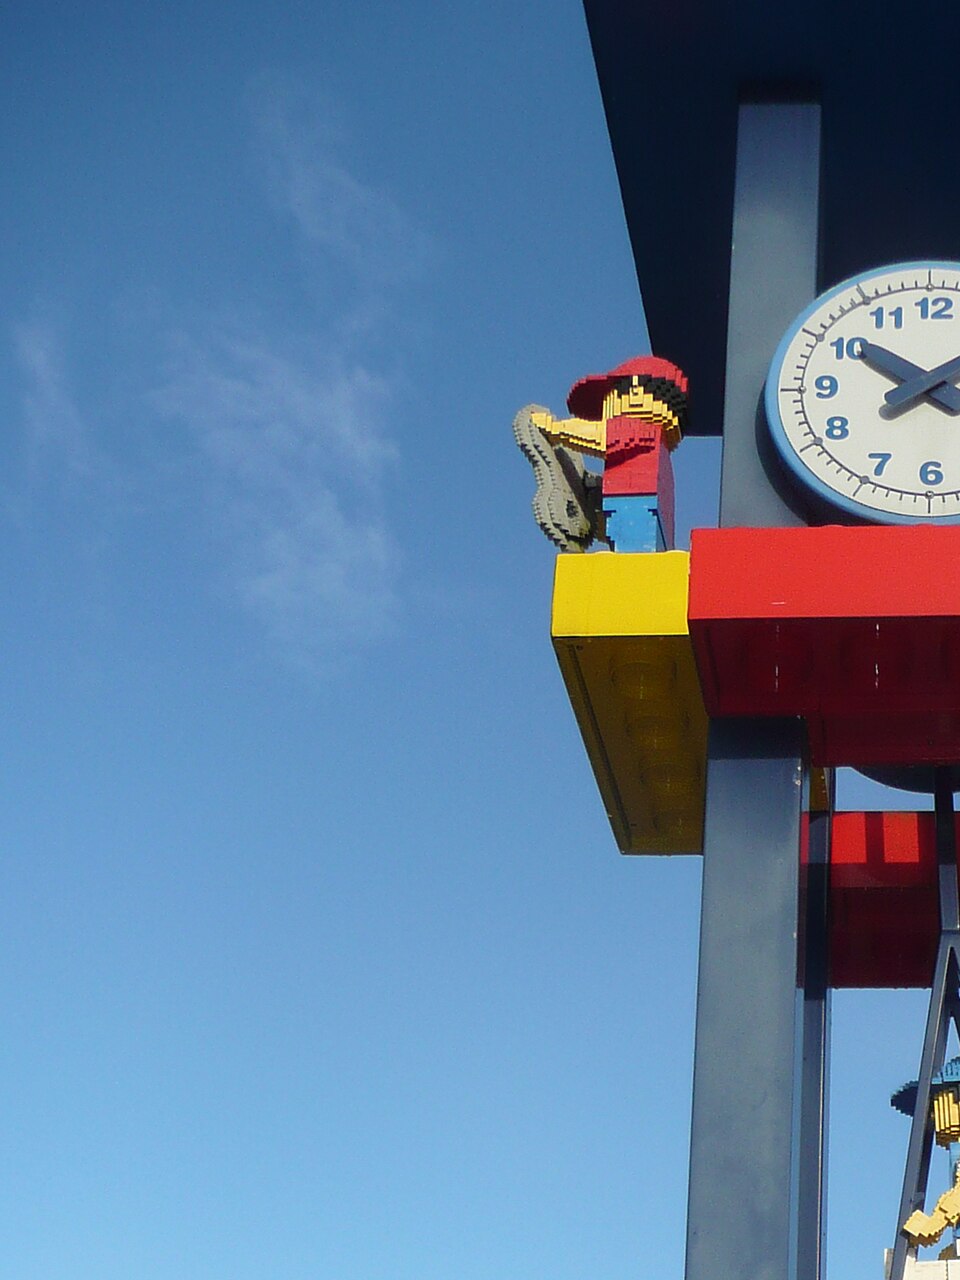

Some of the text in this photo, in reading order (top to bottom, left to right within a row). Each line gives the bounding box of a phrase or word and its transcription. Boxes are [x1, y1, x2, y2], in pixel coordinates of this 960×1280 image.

[870, 306, 904, 330] 11
[914, 297, 954, 320] 12
[830, 337, 868, 360] 10
[814, 375, 839, 400] 9
[825, 416, 850, 441] 8
[868, 452, 892, 477] 7
[919, 461, 944, 486] 6
